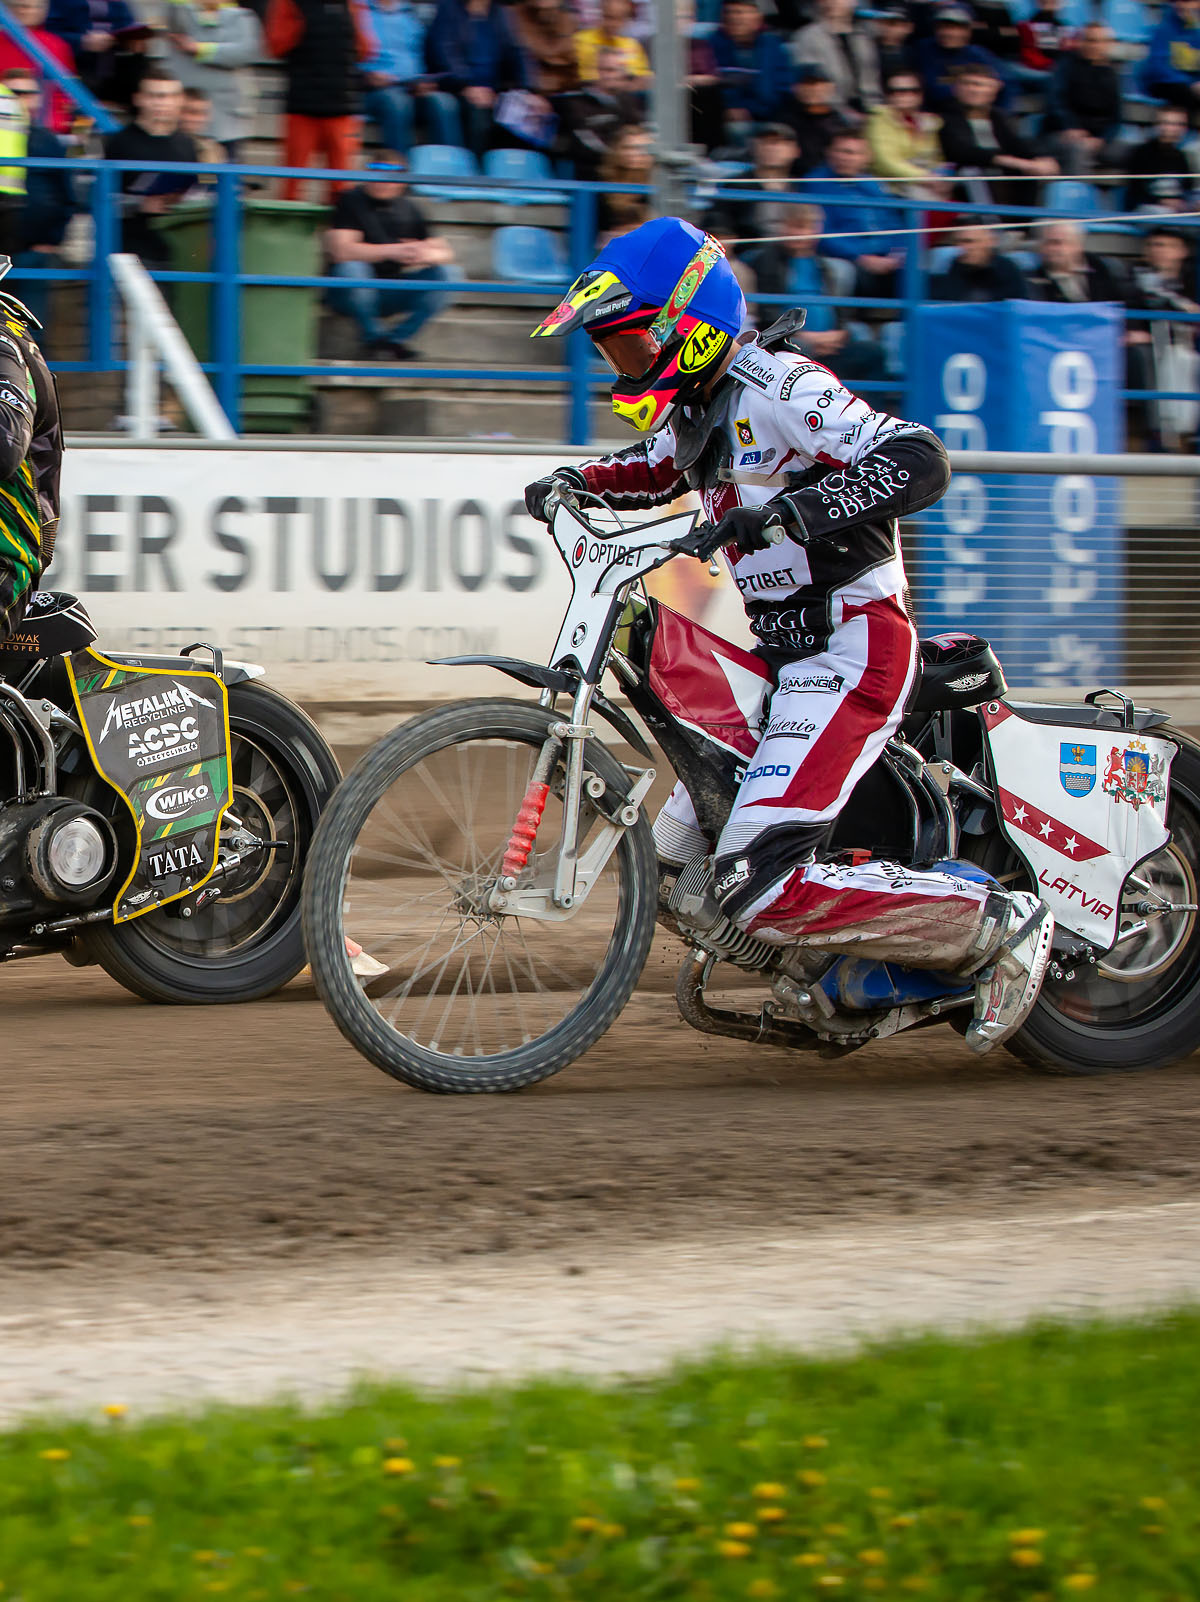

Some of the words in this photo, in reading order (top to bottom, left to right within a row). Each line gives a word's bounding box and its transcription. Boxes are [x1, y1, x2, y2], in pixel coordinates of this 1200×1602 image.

[612, 298, 631, 311] Perfor
[838, 475, 906, 518] BEAR
[203, 496, 544, 593] STUDIOS
[588, 542, 644, 567] OPTIBET
[736, 568, 797, 595] PTIBET
[0, 644, 40, 653] ELOPER
[6, 633, 40, 644] OWAK
[98, 680, 216, 745] METALIKA
[124, 704, 186, 728] RECYCLING
[129, 716, 199, 758] ACDC
[146, 745, 189, 763] RECYCLING
[158, 784, 209, 810] WIKO
[149, 843, 204, 877] TATA
[1038, 868, 1114, 921] LATVIA
